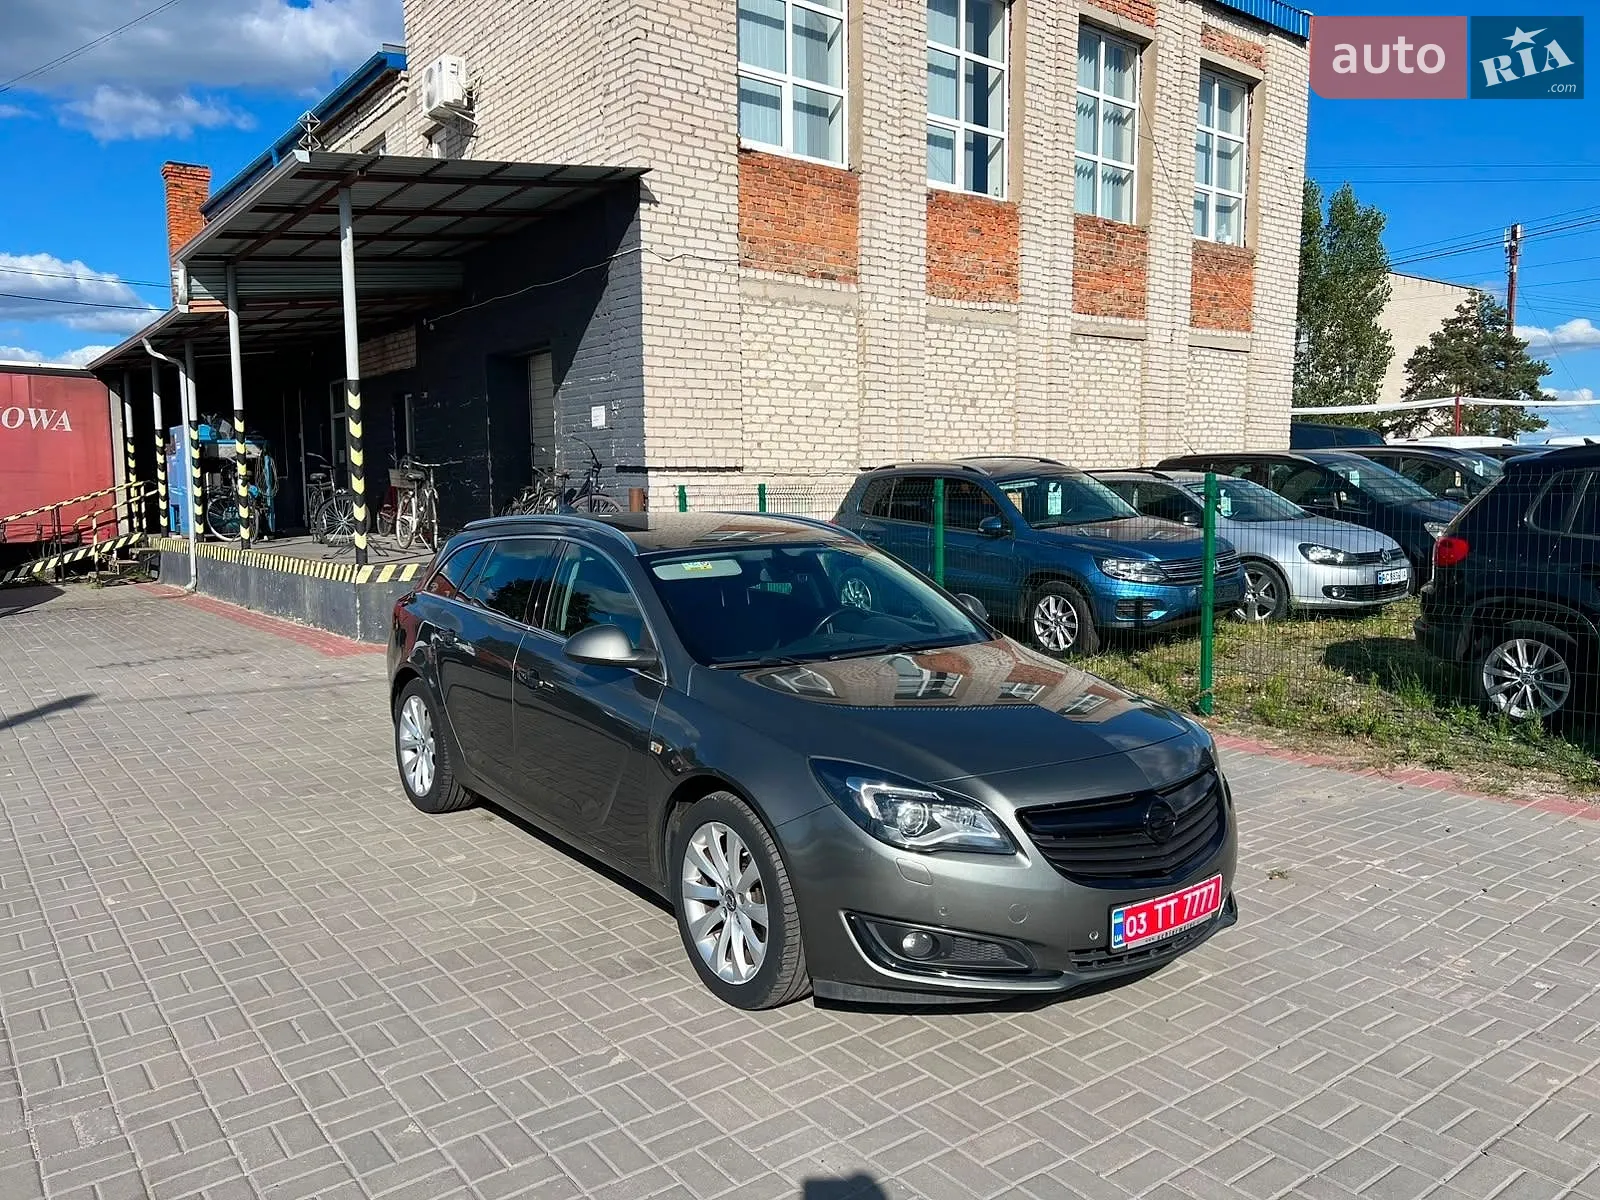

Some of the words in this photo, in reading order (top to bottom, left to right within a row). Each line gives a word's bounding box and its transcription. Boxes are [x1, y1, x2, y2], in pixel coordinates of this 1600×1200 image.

[0, 406, 72, 432] OWA
[1125, 911, 1148, 938] 03
[1154, 898, 1179, 929] TT
[1183, 882, 1216, 920] 7777
